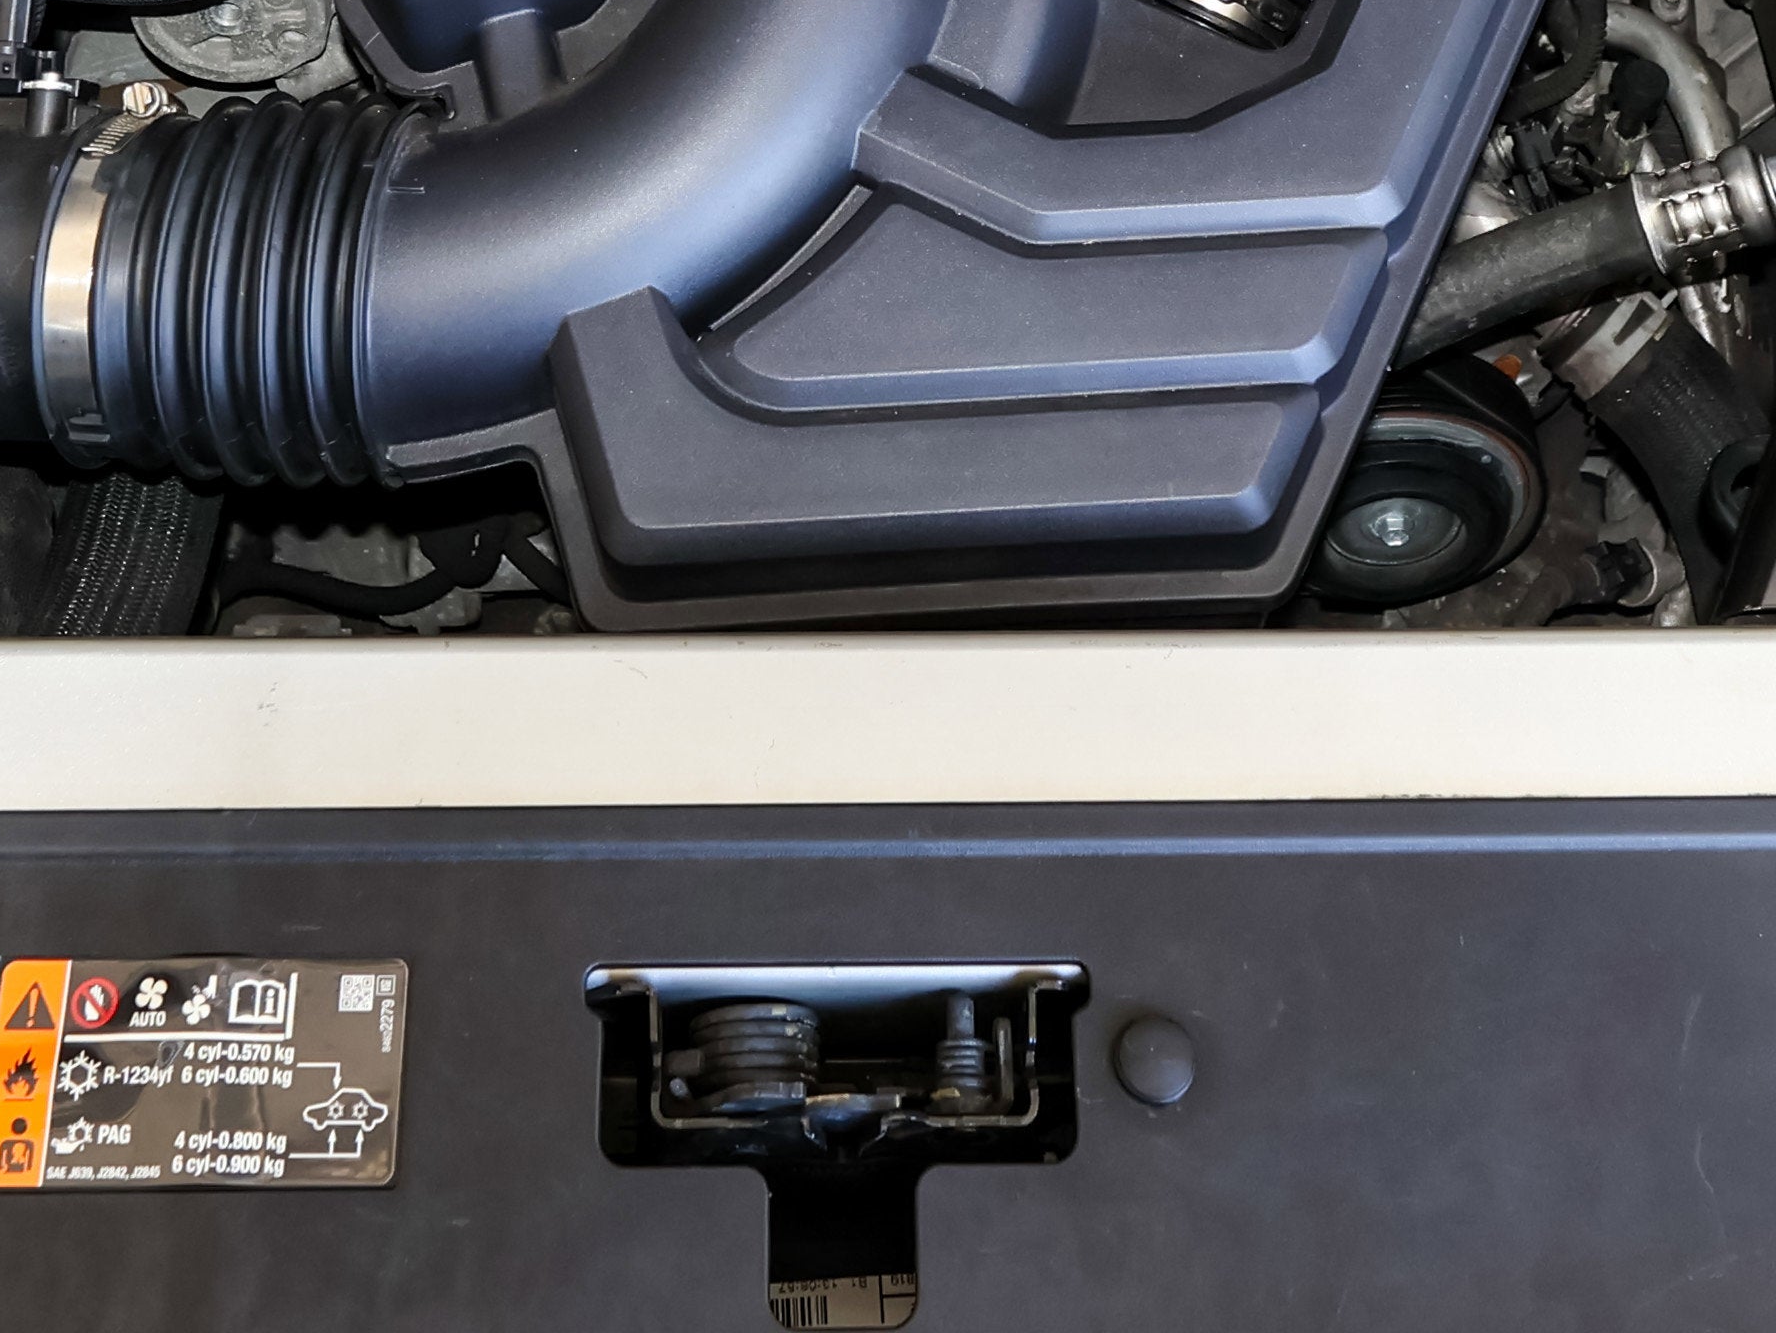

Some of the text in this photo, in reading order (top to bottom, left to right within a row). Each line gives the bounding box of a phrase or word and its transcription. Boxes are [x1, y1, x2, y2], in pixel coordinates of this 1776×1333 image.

[129, 1011, 166, 1027] AUTO
[184, 1042, 295, 1065] 4 cyl-0.570 kg
[103, 1065, 173, 1088] R-1234yf
[181, 1066, 293, 1088] 6 cyl-0.600 kg
[97, 1124, 132, 1144] PAG
[174, 1130, 287, 1155] 4 cyl-0.800 kg
[46, 1165, 68, 1180] SAE
[171, 1153, 285, 1178] 6 cyl-0.900 kg
